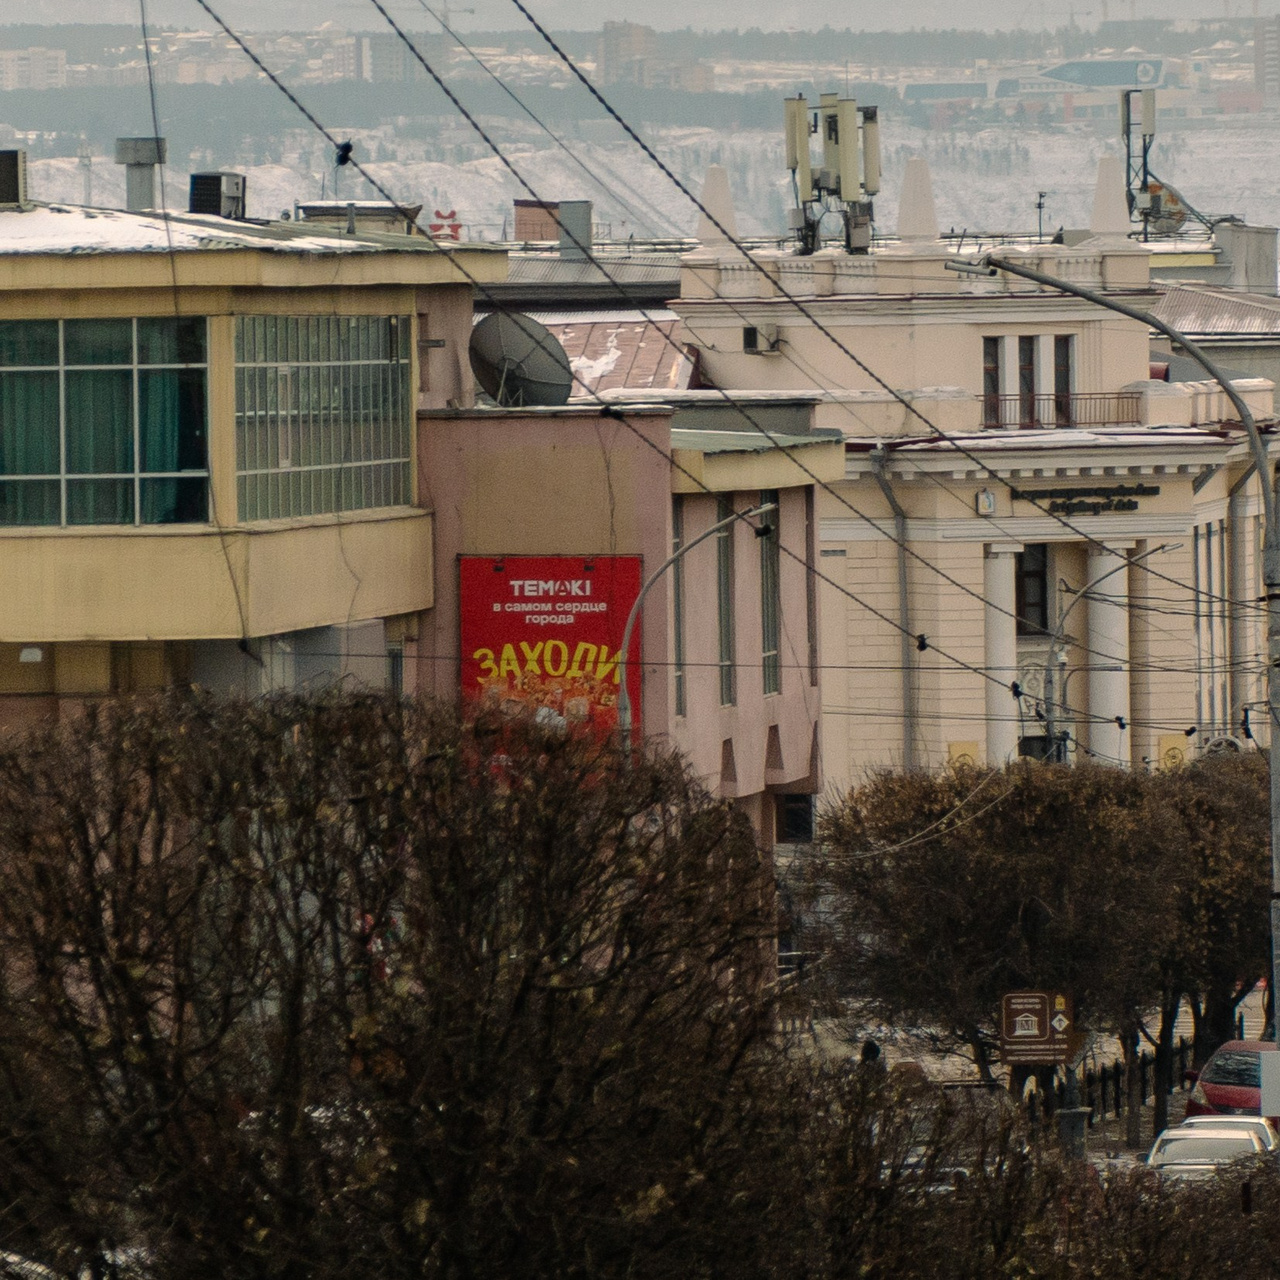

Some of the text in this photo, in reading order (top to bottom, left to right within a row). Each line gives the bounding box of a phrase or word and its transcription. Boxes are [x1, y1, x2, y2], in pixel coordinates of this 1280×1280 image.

[509, 580, 591, 596] TEMAKI
[493, 602, 607, 613] в самом сердце
[525, 615, 574, 625] города
[473, 640, 622, 684] ЗАХОДИ
